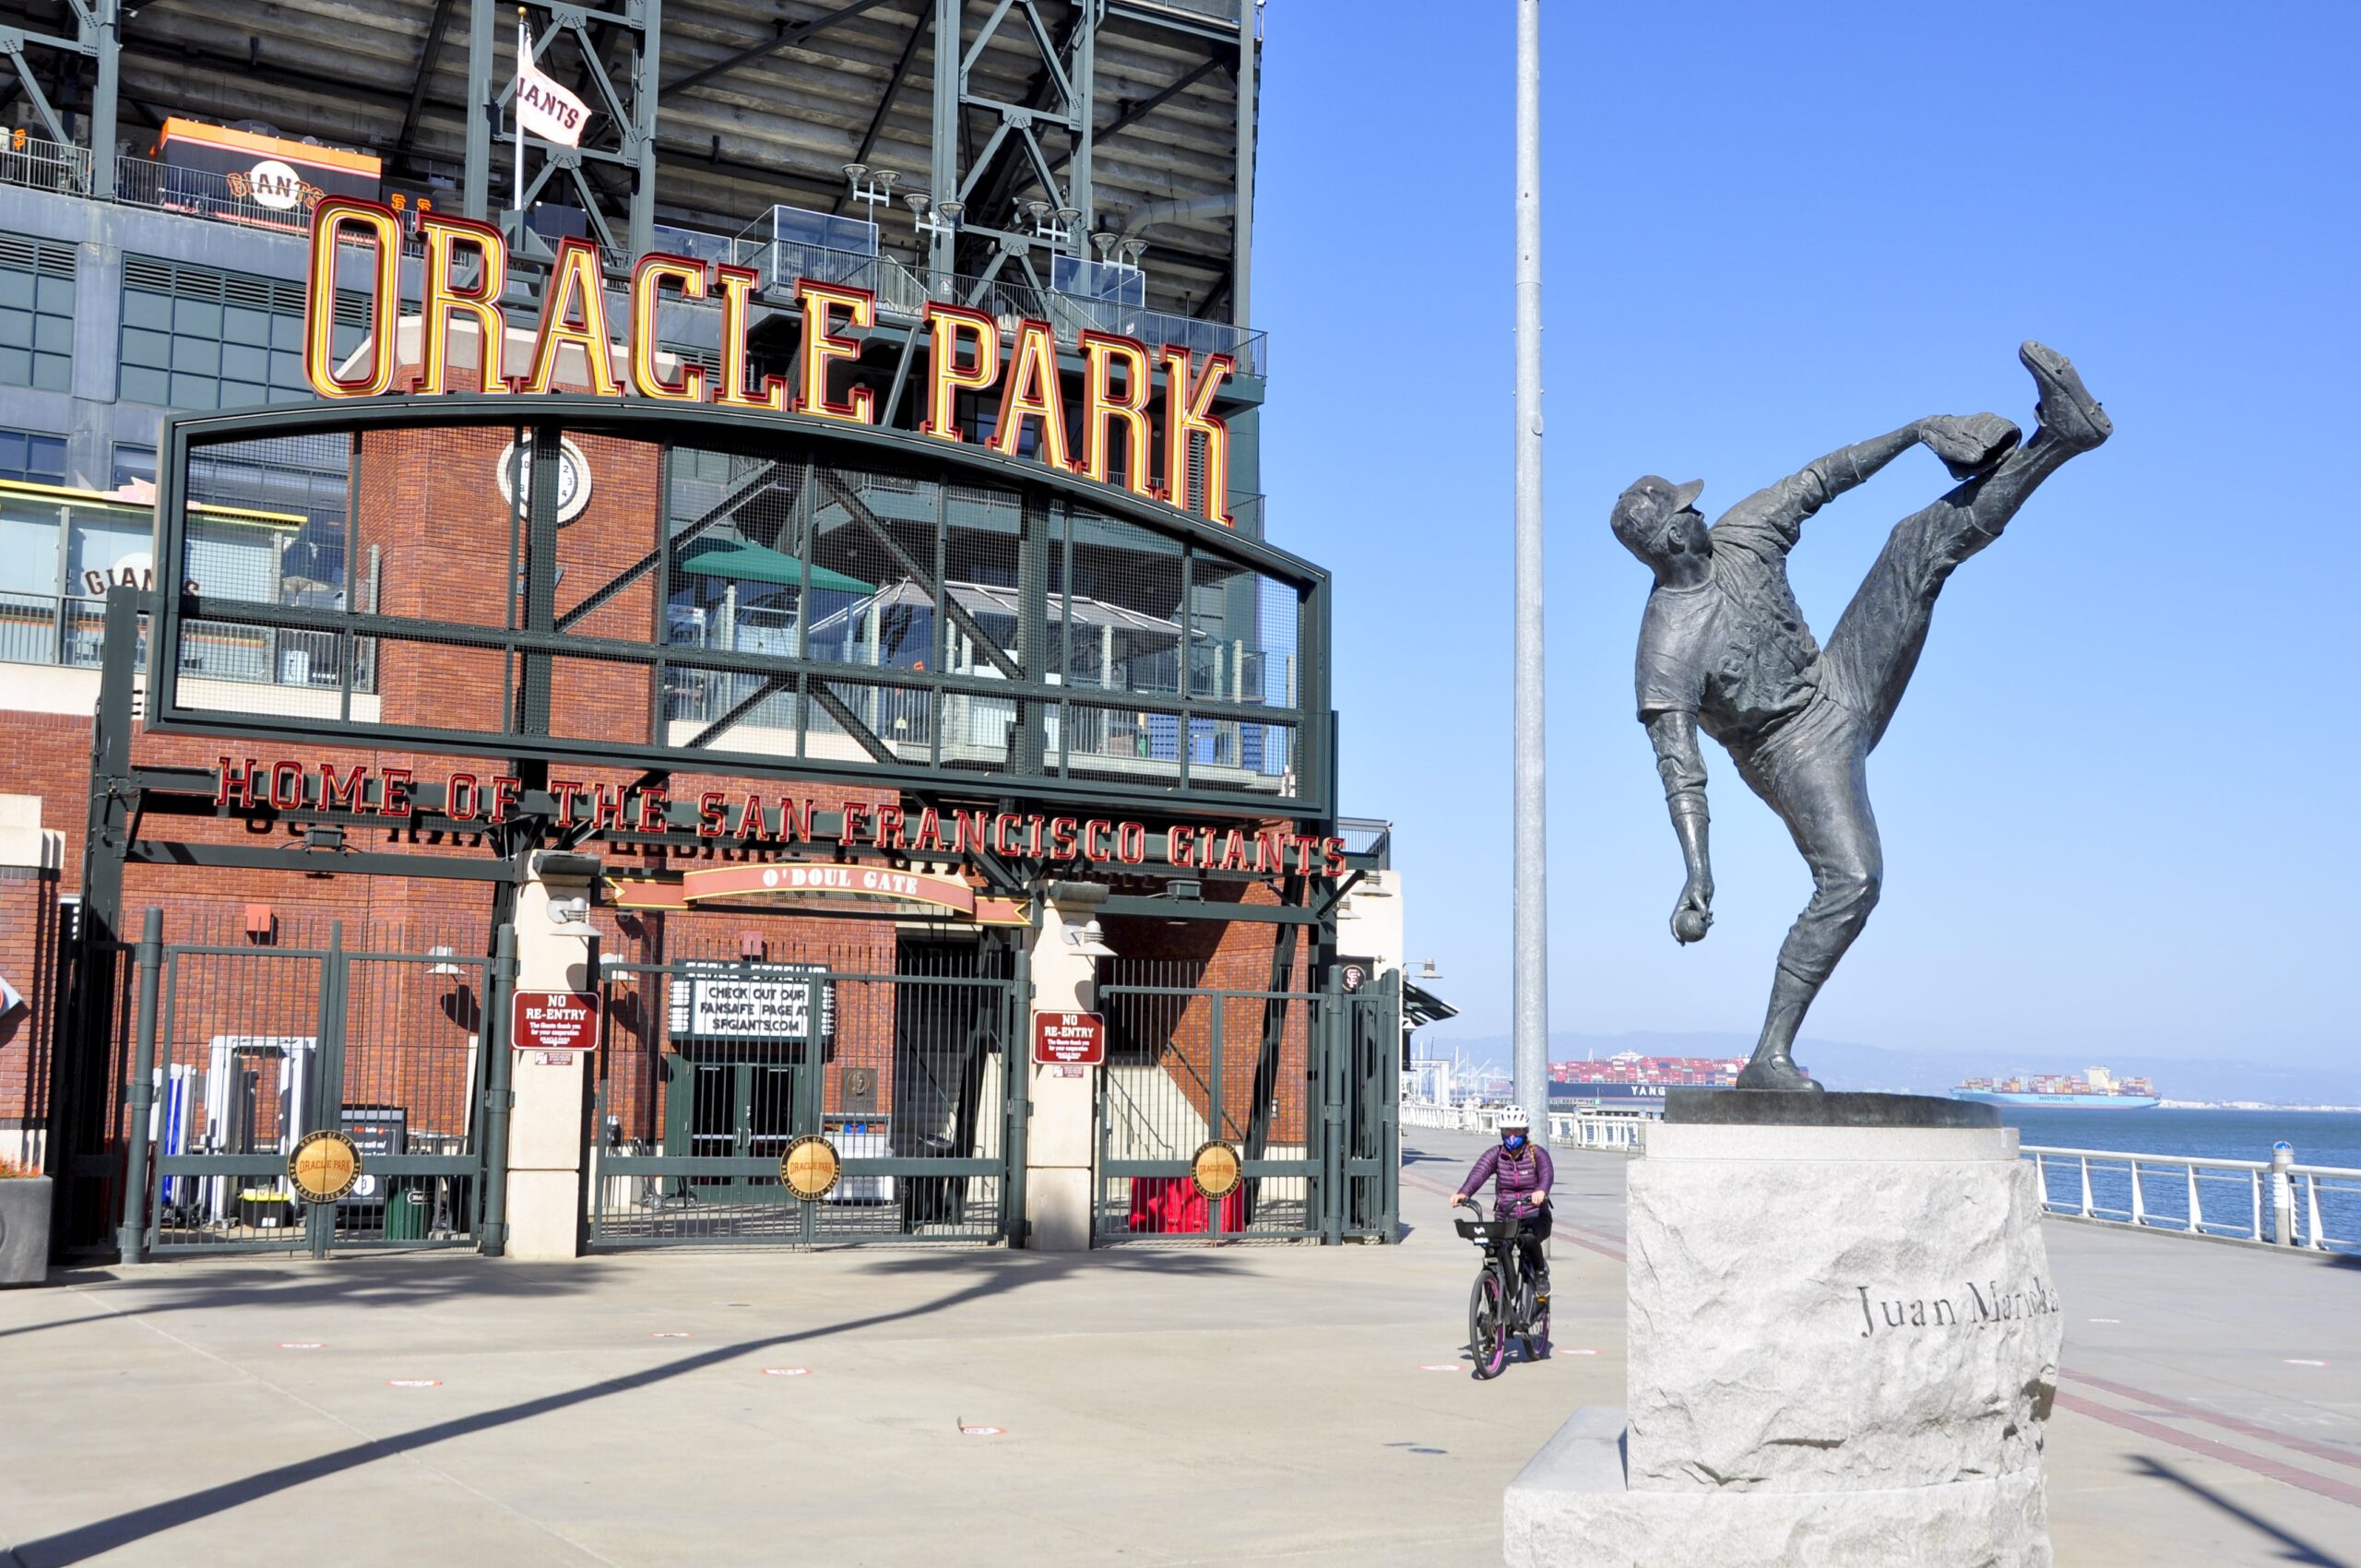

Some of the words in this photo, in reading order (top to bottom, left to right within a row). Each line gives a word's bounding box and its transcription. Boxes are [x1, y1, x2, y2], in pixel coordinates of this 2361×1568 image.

[516, 77, 579, 129] IANTS
[303, 194, 875, 425] ORACLE
[919, 300, 1235, 529] PARK
[85, 567, 199, 596] GIANS
[215, 756, 411, 817] HOME
[445, 773, 521, 824] OF
[550, 779, 668, 835] THE
[697, 792, 813, 843] SAN
[839, 802, 1145, 864] FRANCISCO
[1168, 826, 1346, 877] GIANTS
[763, 868, 851, 887] O'DOUL
[863, 870, 918, 895] GATE
[548, 995, 566, 1007] NO
[708, 987, 748, 1000] CHECK
[753, 988, 777, 1000] OUT
[780, 990, 805, 1002] OUR
[526, 1008, 587, 1020] RE-ENTRY
[700, 1002, 754, 1015] FANSAFE
[762, 1004, 793, 1016] PAGE
[1062, 1015, 1077, 1026] NO
[1044, 1027, 1094, 1038] RE-ENTRY
[1631, 1086, 1666, 1096] YANG
[300, 1159, 331, 1173] ORACLE
[333, 1159, 350, 1173] PARK
[1857, 1286, 1957, 1337] Juan
[1966, 1277, 2058, 1324] Maricha
